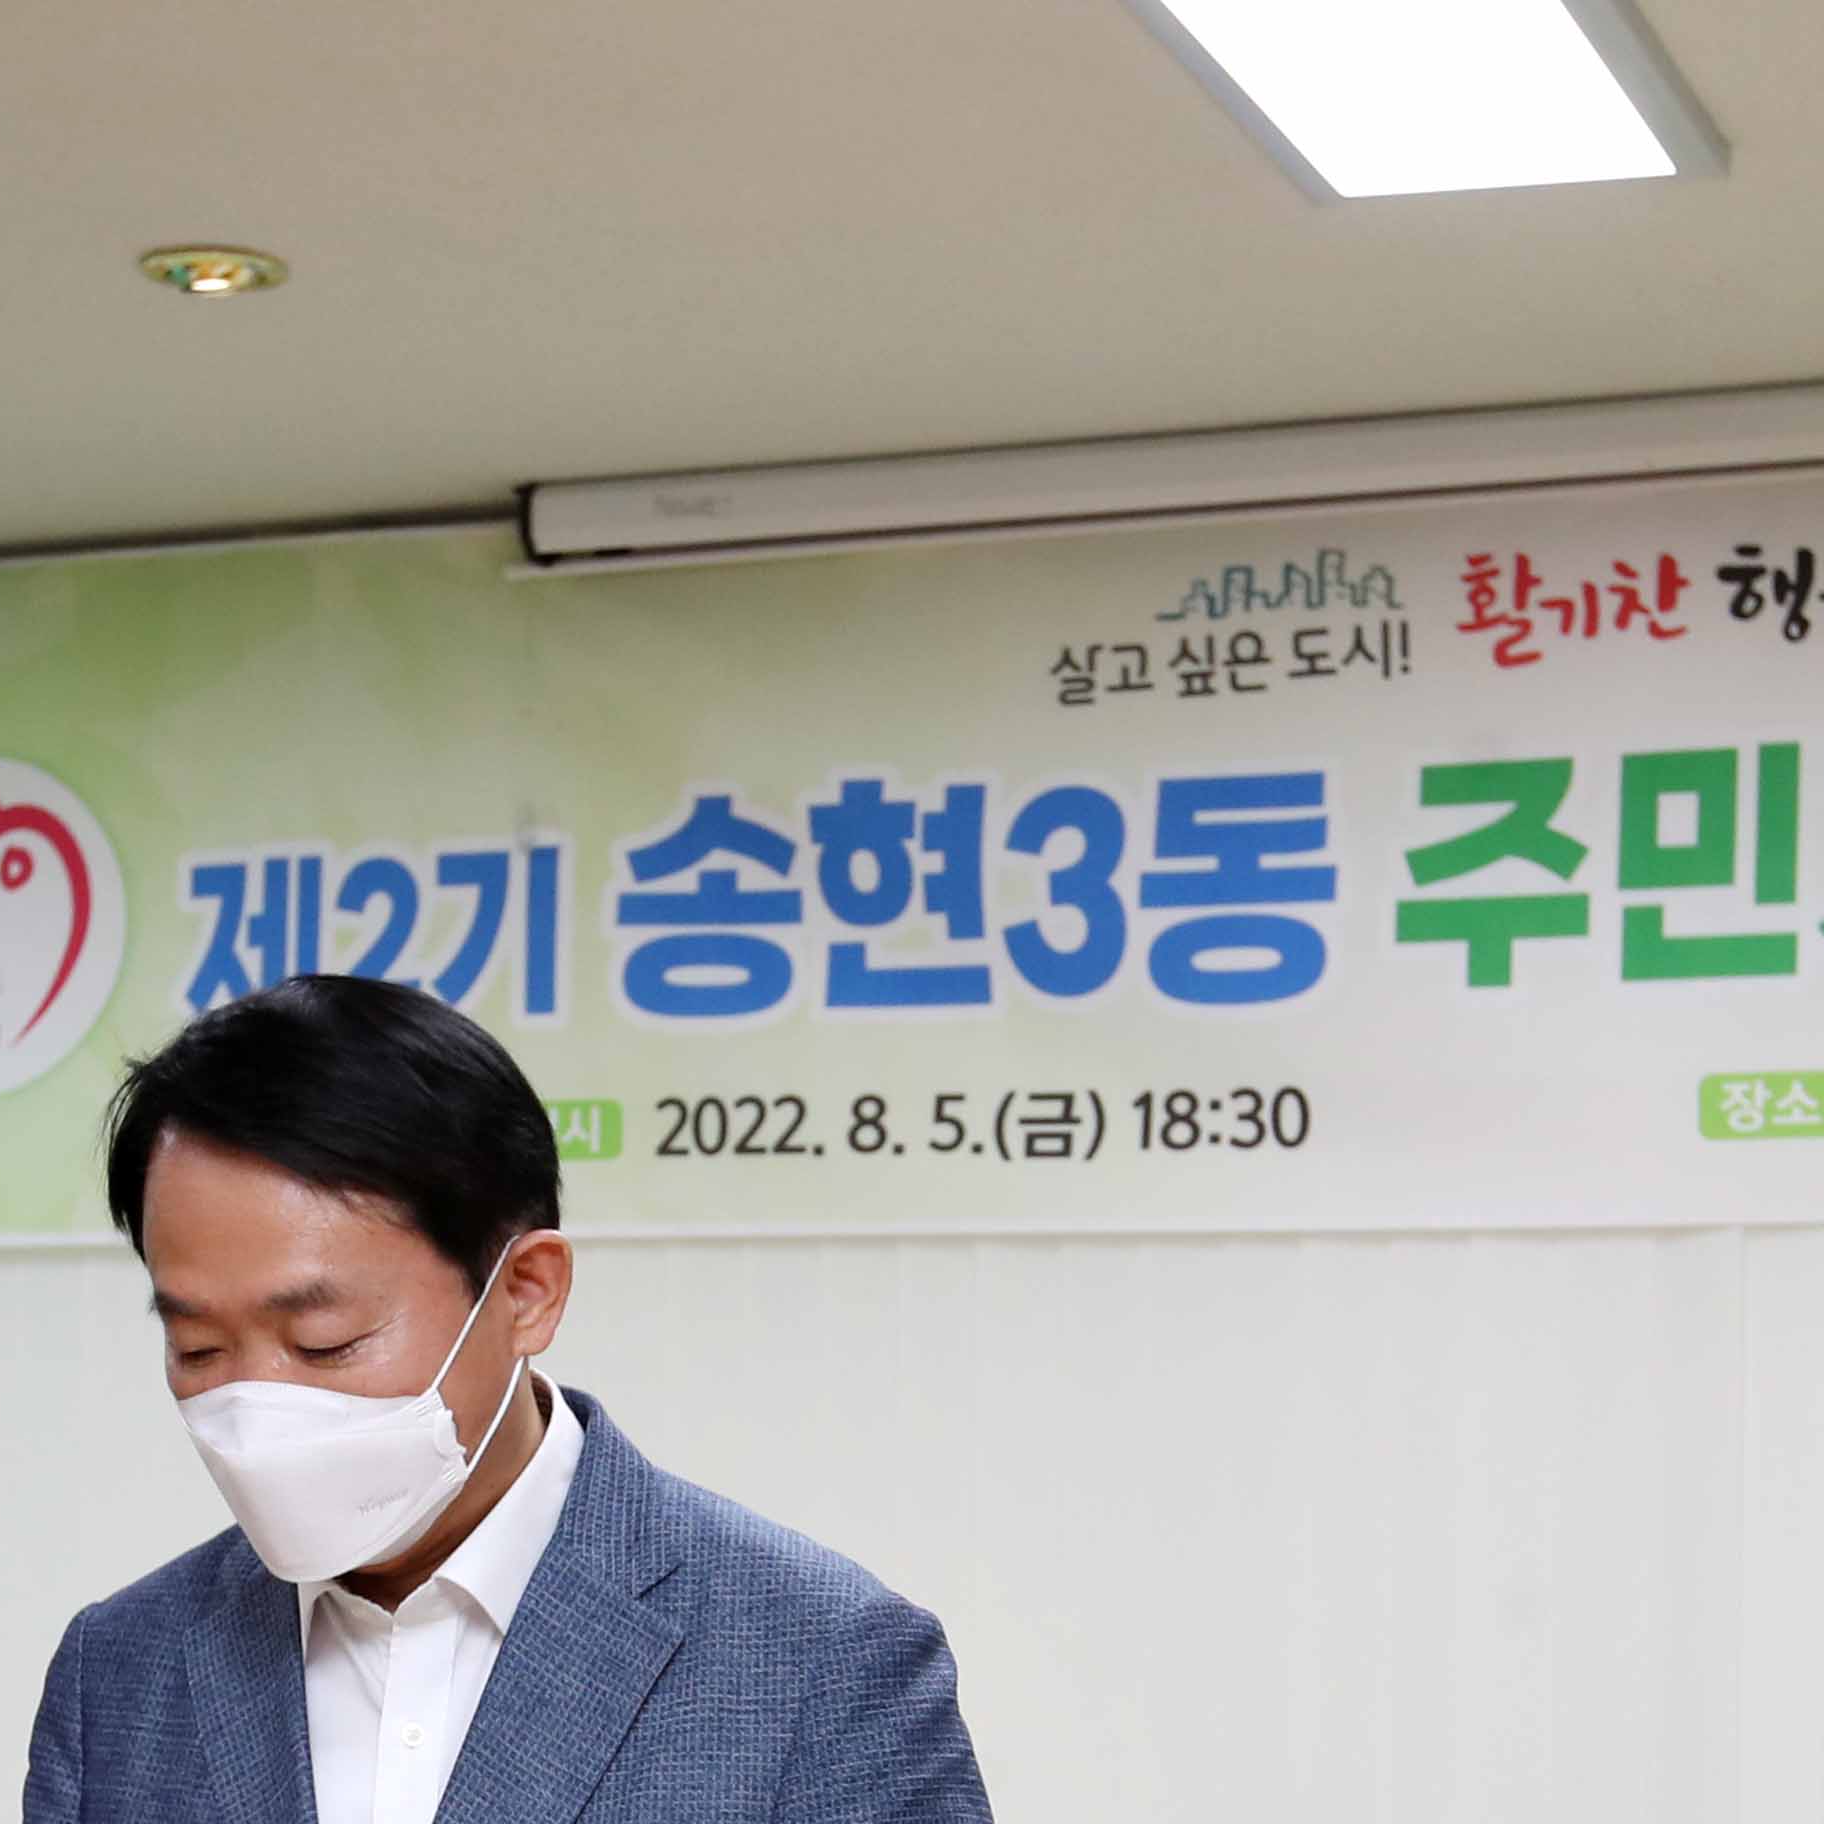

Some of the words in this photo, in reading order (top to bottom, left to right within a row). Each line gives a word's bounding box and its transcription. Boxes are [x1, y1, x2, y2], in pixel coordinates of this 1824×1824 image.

[1456, 550, 1692, 670] 활기찬
[1049, 642, 1155, 707] 살고
[1166, 628, 1272, 700] 싶은
[1286, 618, 1411, 679] 도시!
[185, 846, 560, 1015] 제2기
[616, 770, 1338, 1018] 송현3동
[548, 1104, 602, 1154] 시
[656, 1095, 825, 1156] 2022.
[847, 1094, 905, 1155] 8.
[1132, 1087, 1311, 1150] 18:30
[1719, 1079, 1824, 1133] 장소
